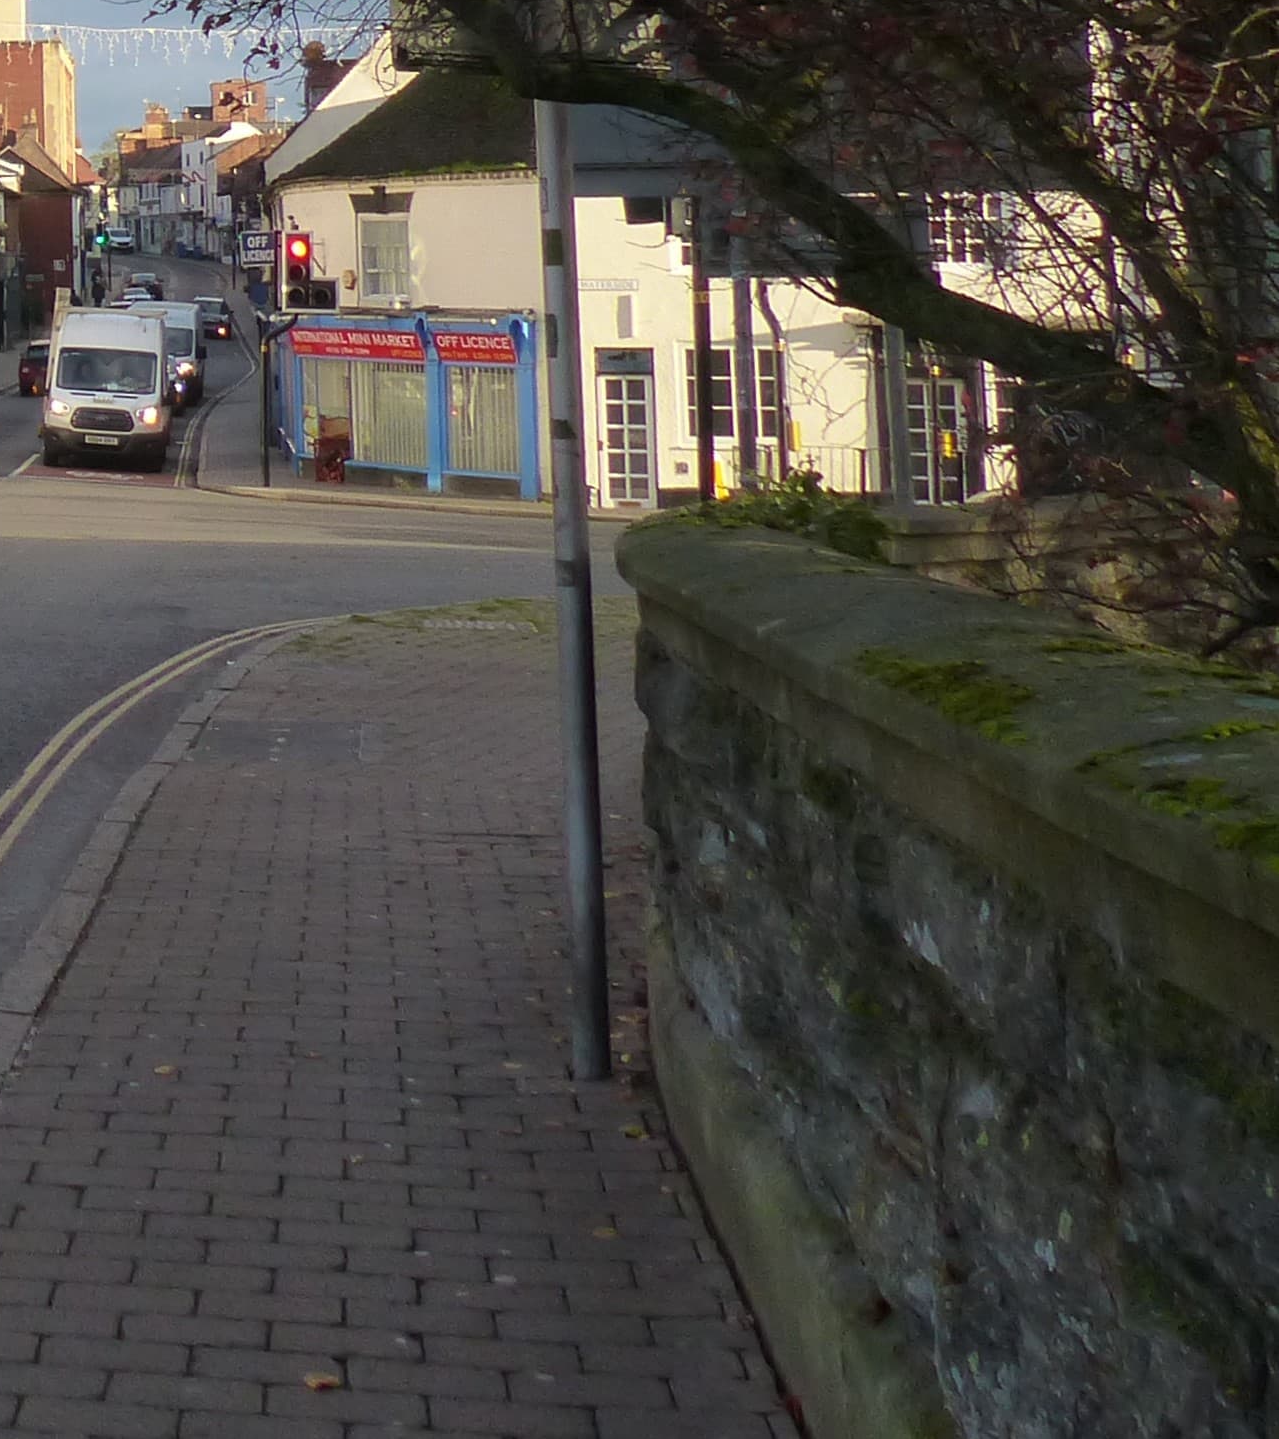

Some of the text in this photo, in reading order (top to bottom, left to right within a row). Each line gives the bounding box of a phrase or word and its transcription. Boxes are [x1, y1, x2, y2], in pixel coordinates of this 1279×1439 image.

[247, 235, 268, 248] OFF
[347, 332, 371, 346] MINI
[371, 333, 416, 348] MARKET
[436, 335, 510, 349] OFF LICENCE
